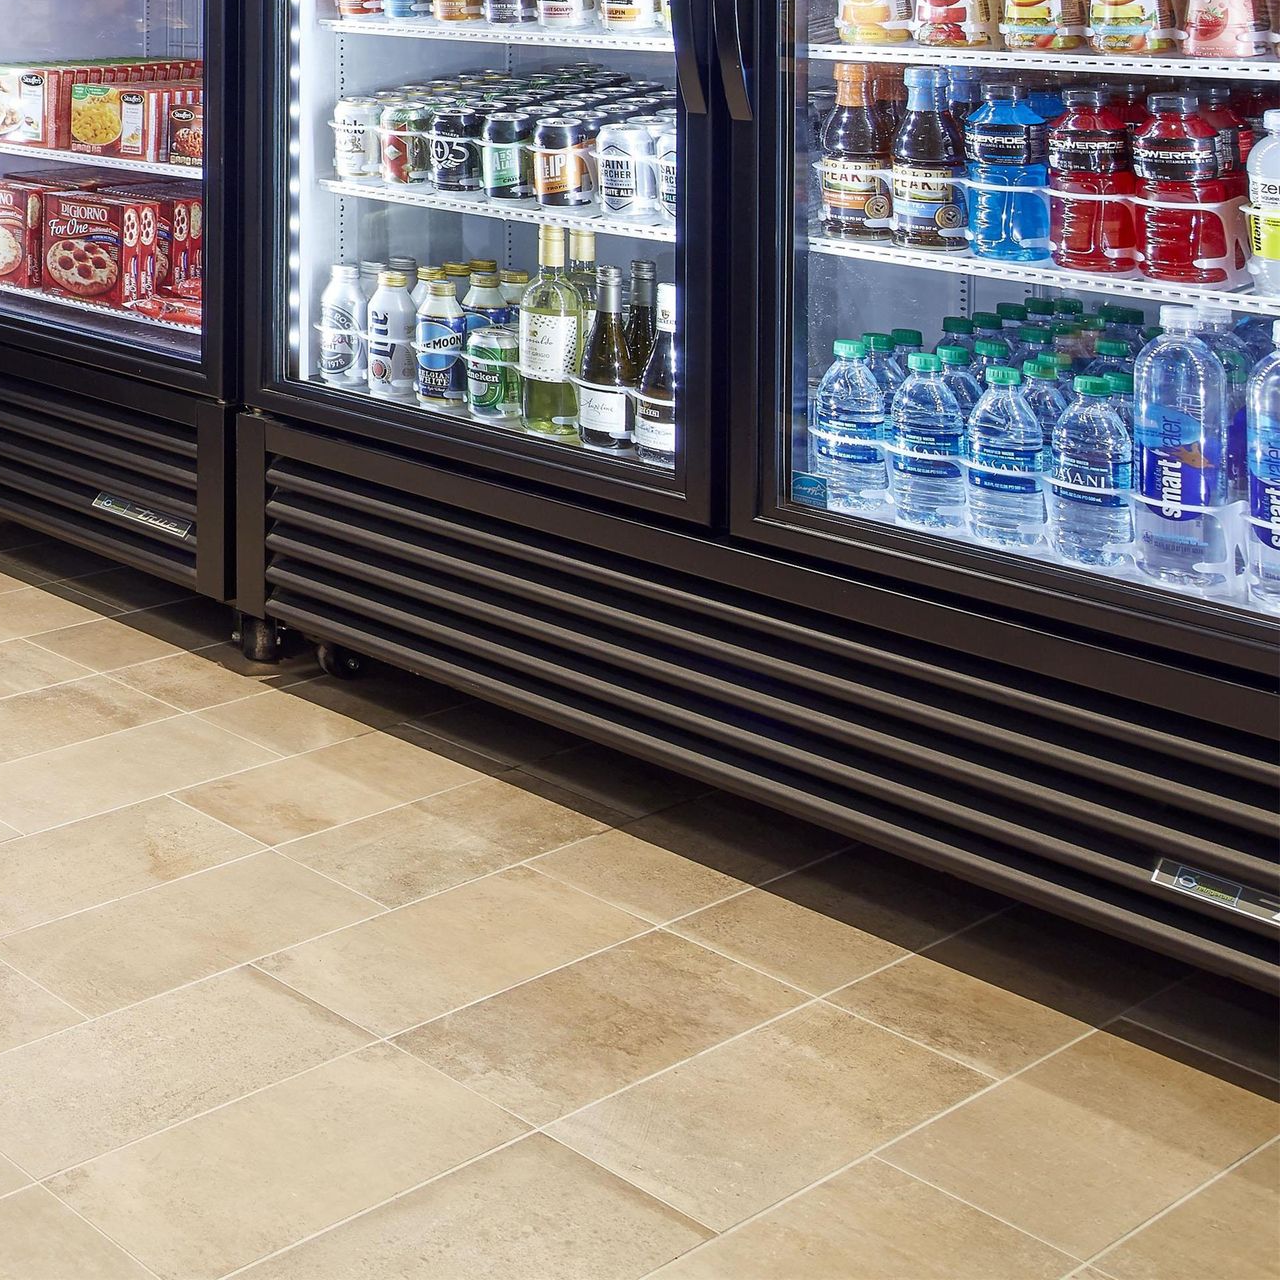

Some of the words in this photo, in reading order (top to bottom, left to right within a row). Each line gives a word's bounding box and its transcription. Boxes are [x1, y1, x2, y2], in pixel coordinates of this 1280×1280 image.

[1048, 138, 1124, 150] POWERADE
[1132, 147, 1213, 160] POWERADE
[49, 219, 66, 236] For
[66, 218, 88, 235] One
[433, 336, 462, 350] MOON
[1054, 467, 1105, 488] DASANI
[1157, 459, 1182, 519] smart
